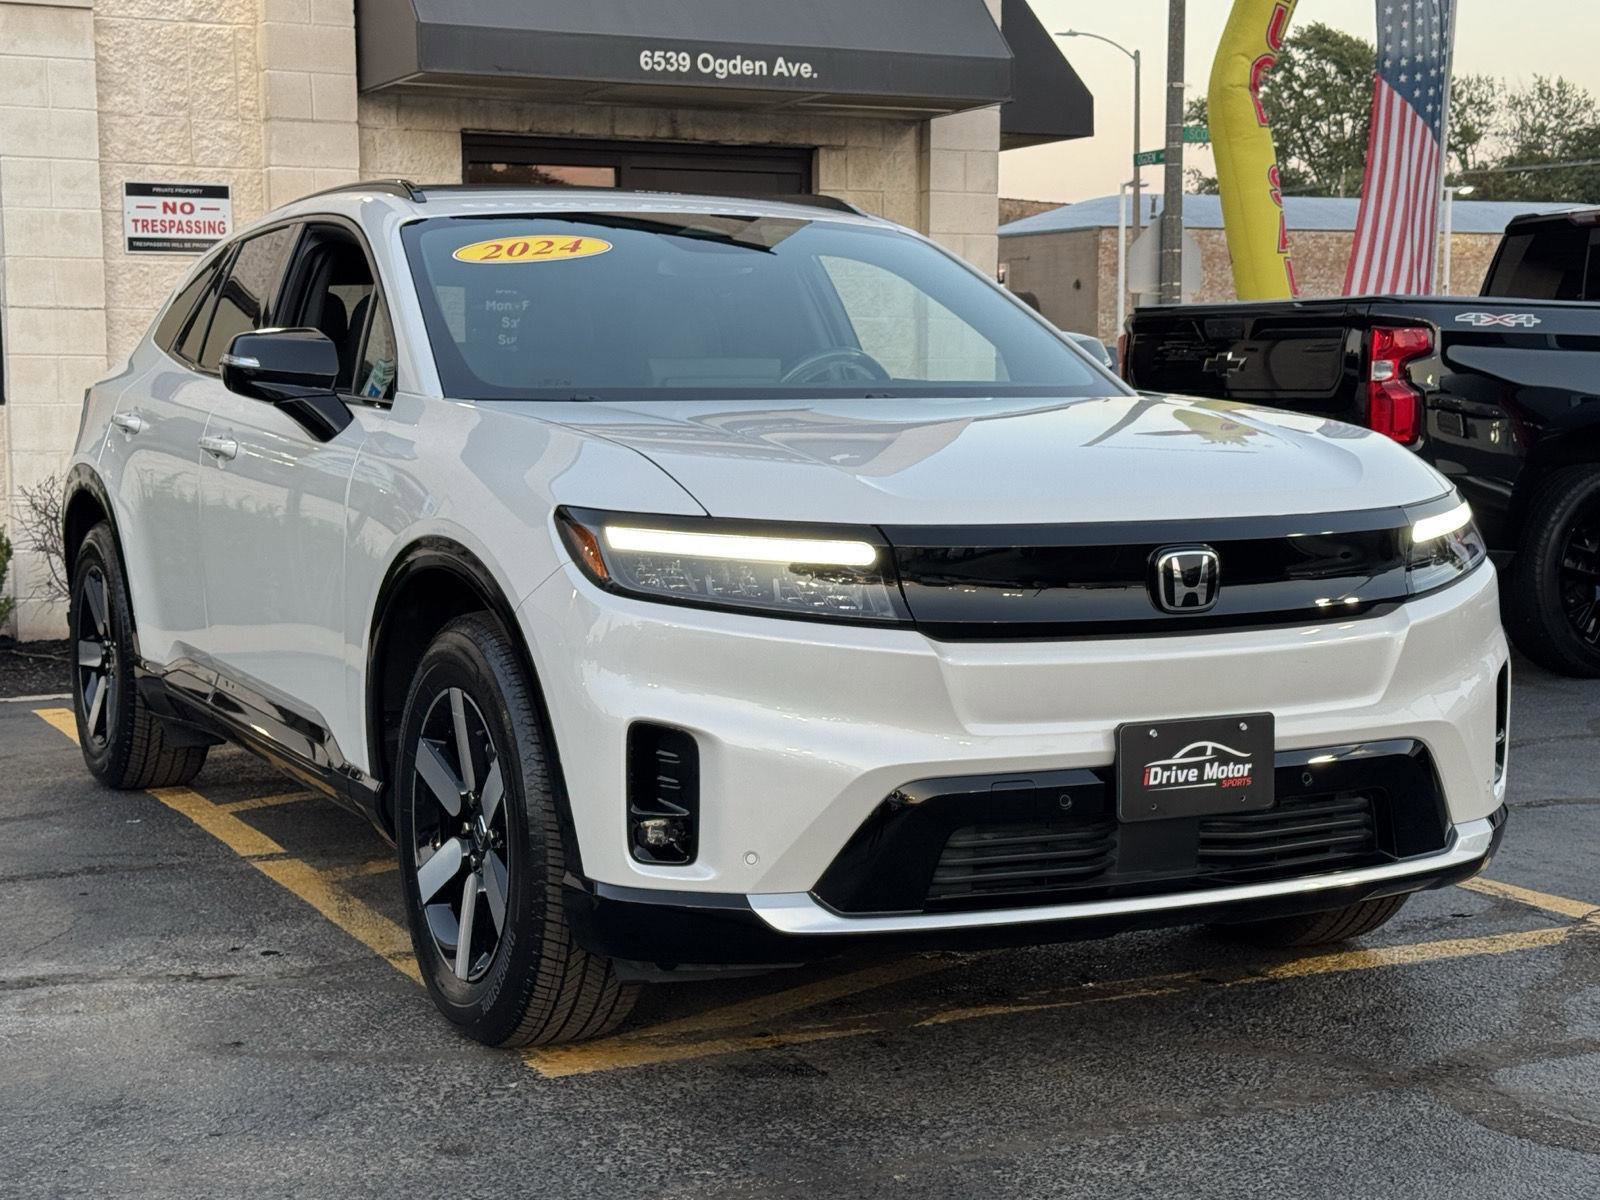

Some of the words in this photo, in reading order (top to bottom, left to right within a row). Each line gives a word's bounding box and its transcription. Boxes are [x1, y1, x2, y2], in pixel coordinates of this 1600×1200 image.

[639, 50, 691, 73] 6539
[697, 52, 768, 79] Ogden
[772, 56, 818, 79] Ave.
[162, 201, 195, 215] NO
[131, 219, 226, 235] TRESPASSING
[480, 238, 583, 260] 2024
[1143, 765, 1198, 786] iDrive
[1203, 761, 1252, 780] Motor
[1221, 777, 1252, 788] SPORTS
